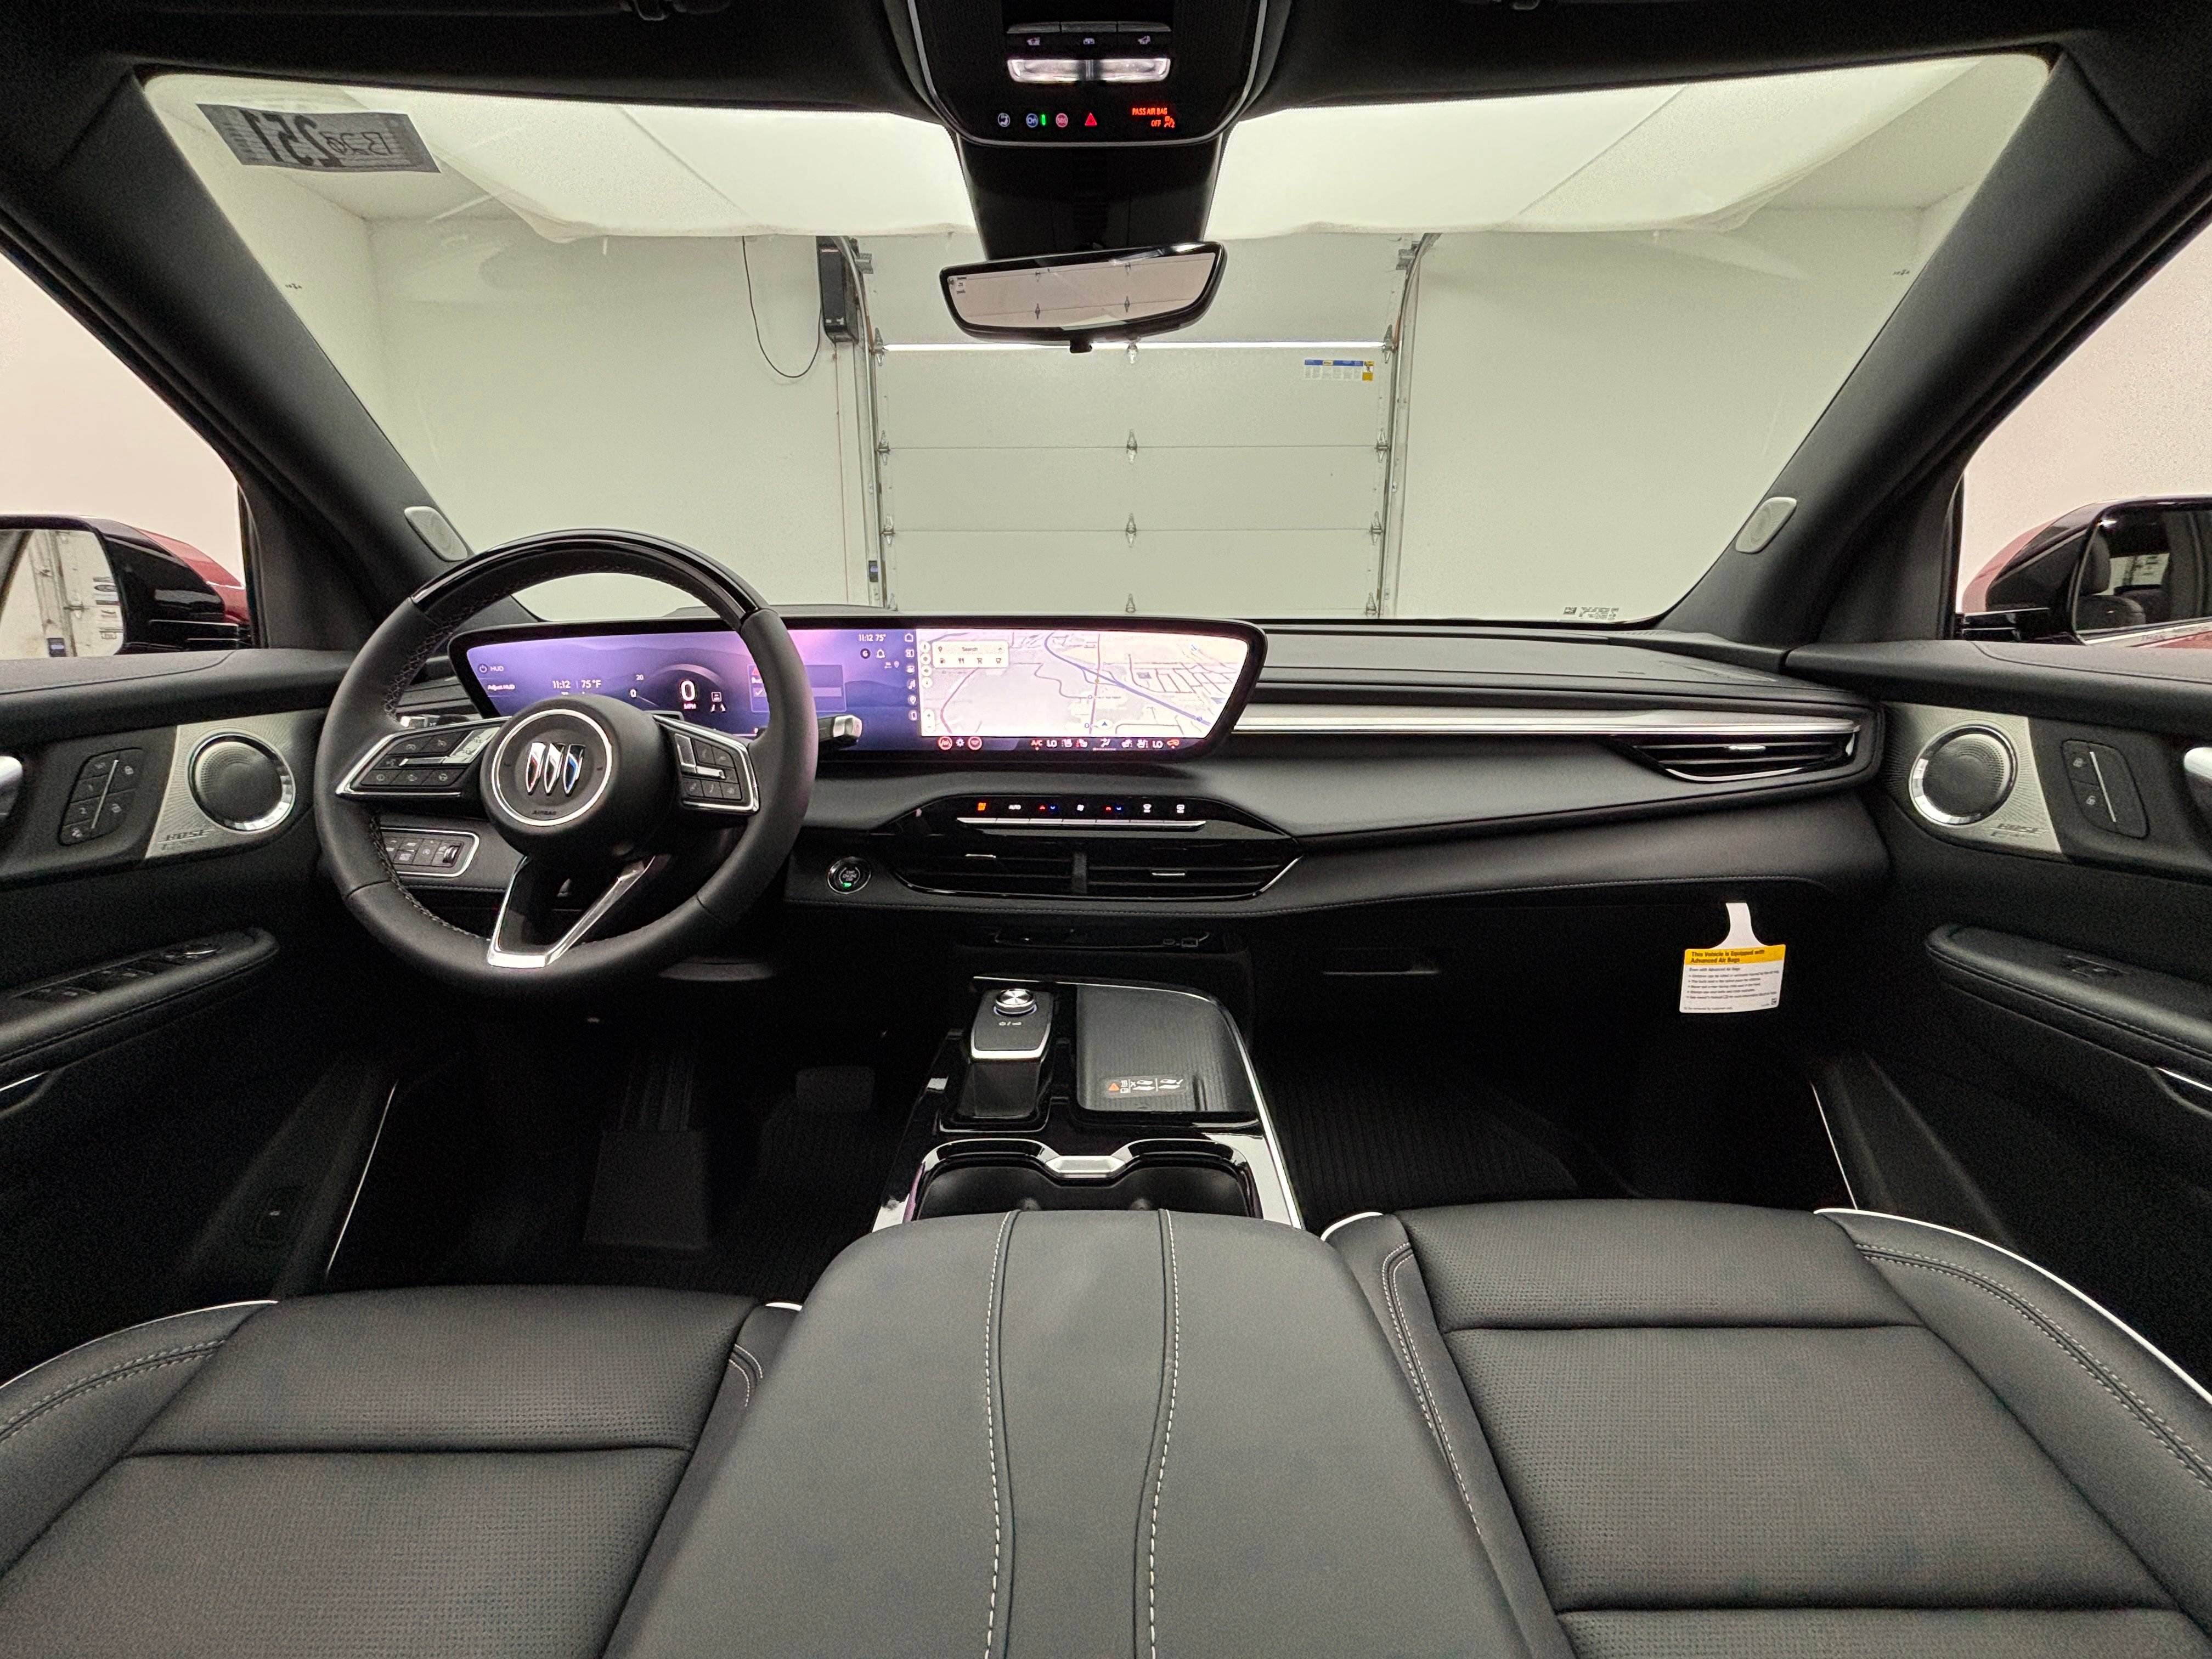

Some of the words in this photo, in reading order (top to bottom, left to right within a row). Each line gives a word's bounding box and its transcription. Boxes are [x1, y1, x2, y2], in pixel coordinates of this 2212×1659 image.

[552, 680, 571, 689] 11:12
[630, 689, 636, 697] 0
[681, 680, 696, 702] 0
[166, 829, 211, 840] BOSE
